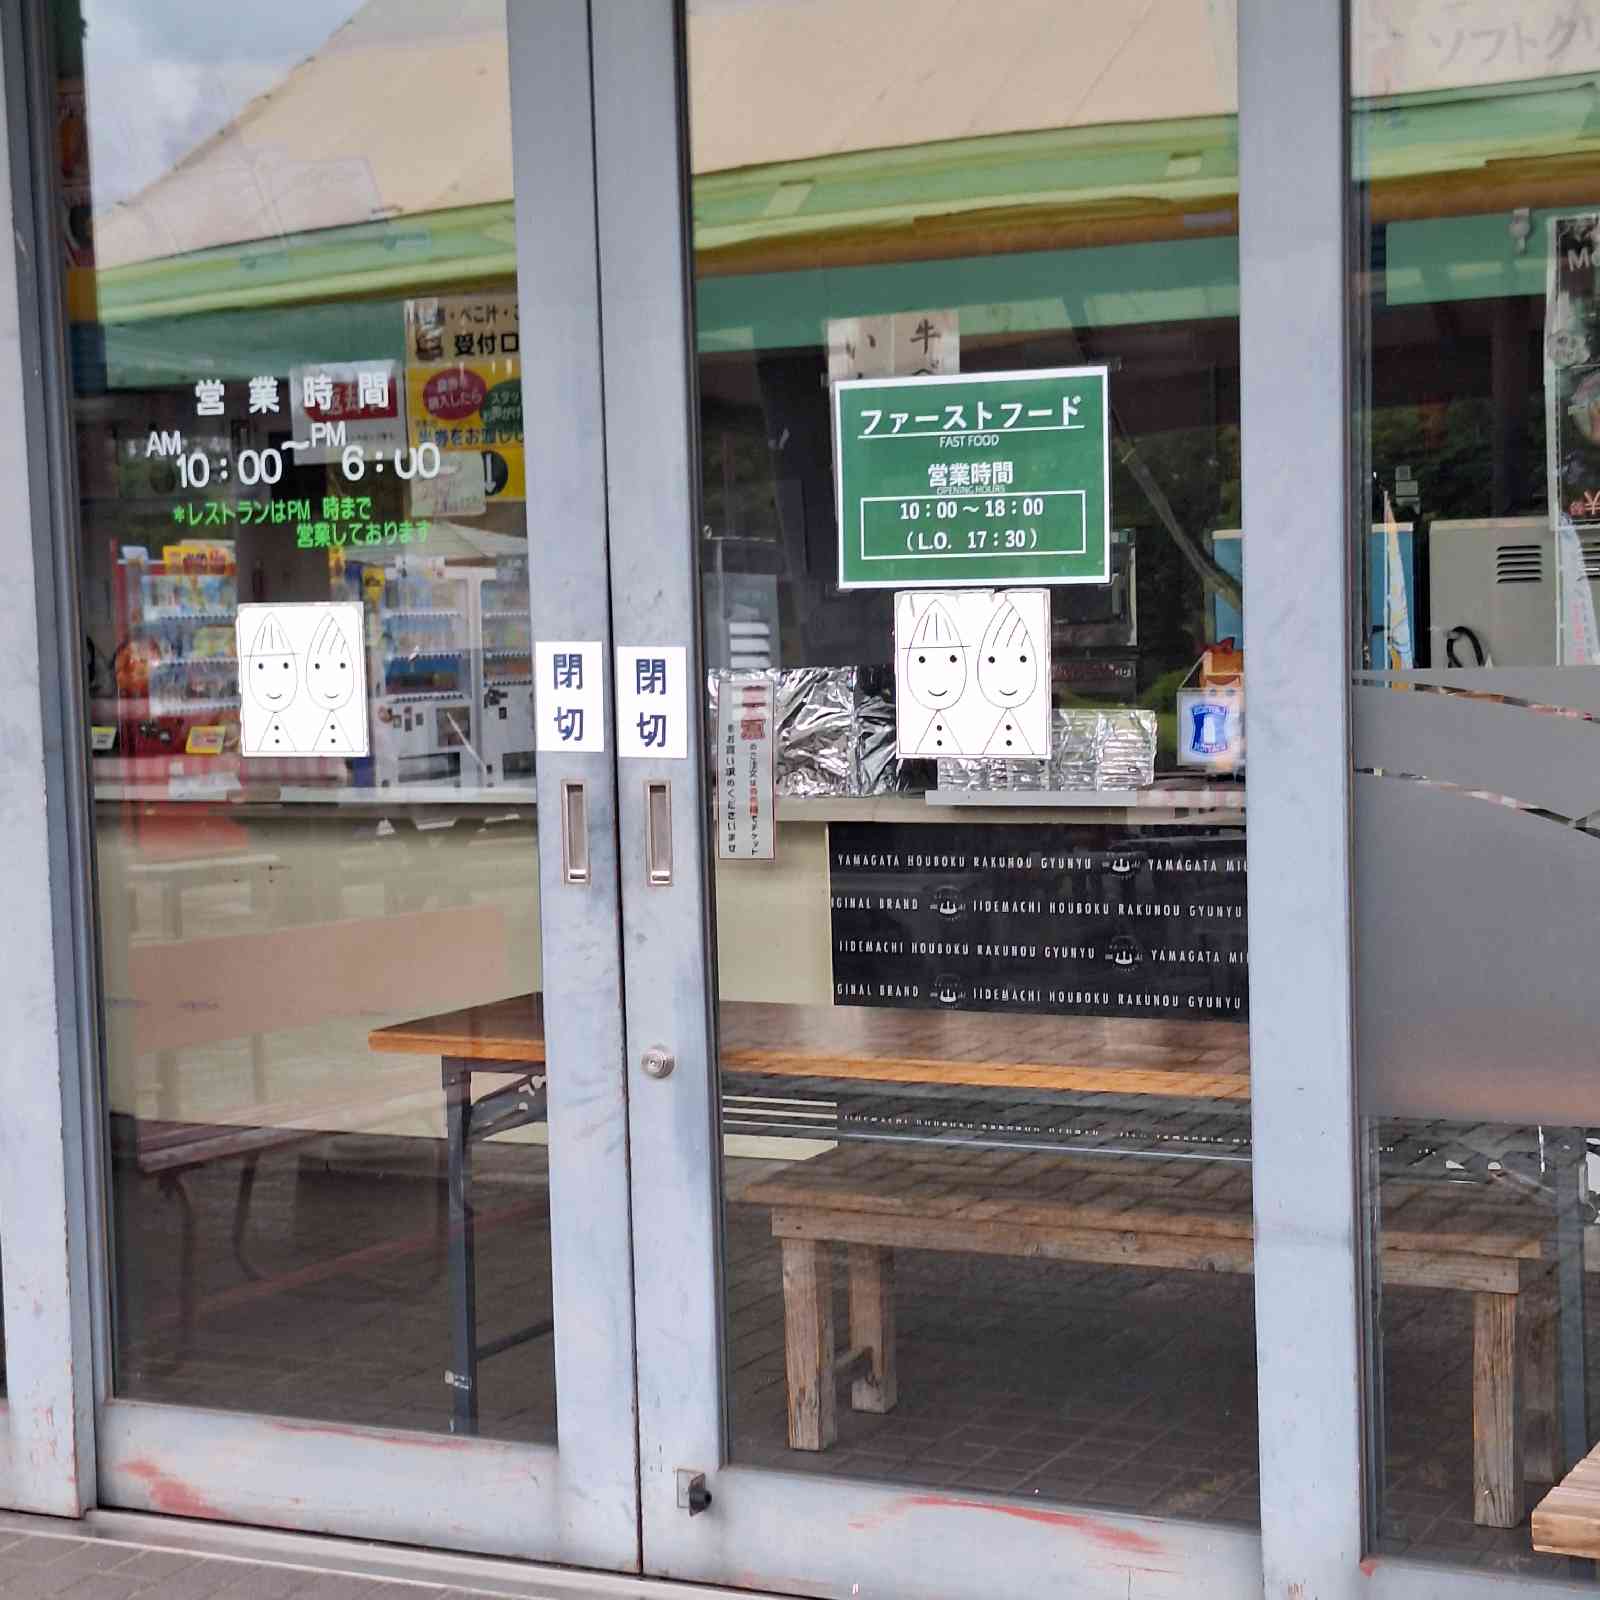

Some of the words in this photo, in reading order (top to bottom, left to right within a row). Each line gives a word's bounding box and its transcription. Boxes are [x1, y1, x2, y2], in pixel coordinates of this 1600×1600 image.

[453, 332, 519, 357] 受付口
[194, 371, 389, 416] 営業時間
[860, 394, 1082, 435] ファーストフード
[146, 430, 182, 457] AM
[311, 420, 347, 449] PM
[939, 435, 965, 448] FAST
[968, 434, 999, 447] FOOD
[927, 461, 1014, 487] 営業時間
[553, 653, 584, 742] 閉切
[635, 658, 667, 748] 閉切
[838, 854, 900, 868] YAMAGATA
[907, 854, 965, 868] HOUBOKU
[1041, 857, 1092, 870] GYUNYU
[1148, 859, 1217, 872] YAMAGATA
[879, 898, 918, 910] BRAND
[1049, 901, 1110, 915] HOUBOKU
[1189, 904, 1242, 918] GYUNYU
[911, 942, 969, 955] HOUBOKU
[1044, 946, 1095, 960] GYUNYU
[1151, 949, 1220, 963] YAMAGATA
[879, 985, 919, 998] BRAND
[1049, 990, 1110, 1005] HOUBOKU
[1188, 995, 1241, 1009] GYUNYU
